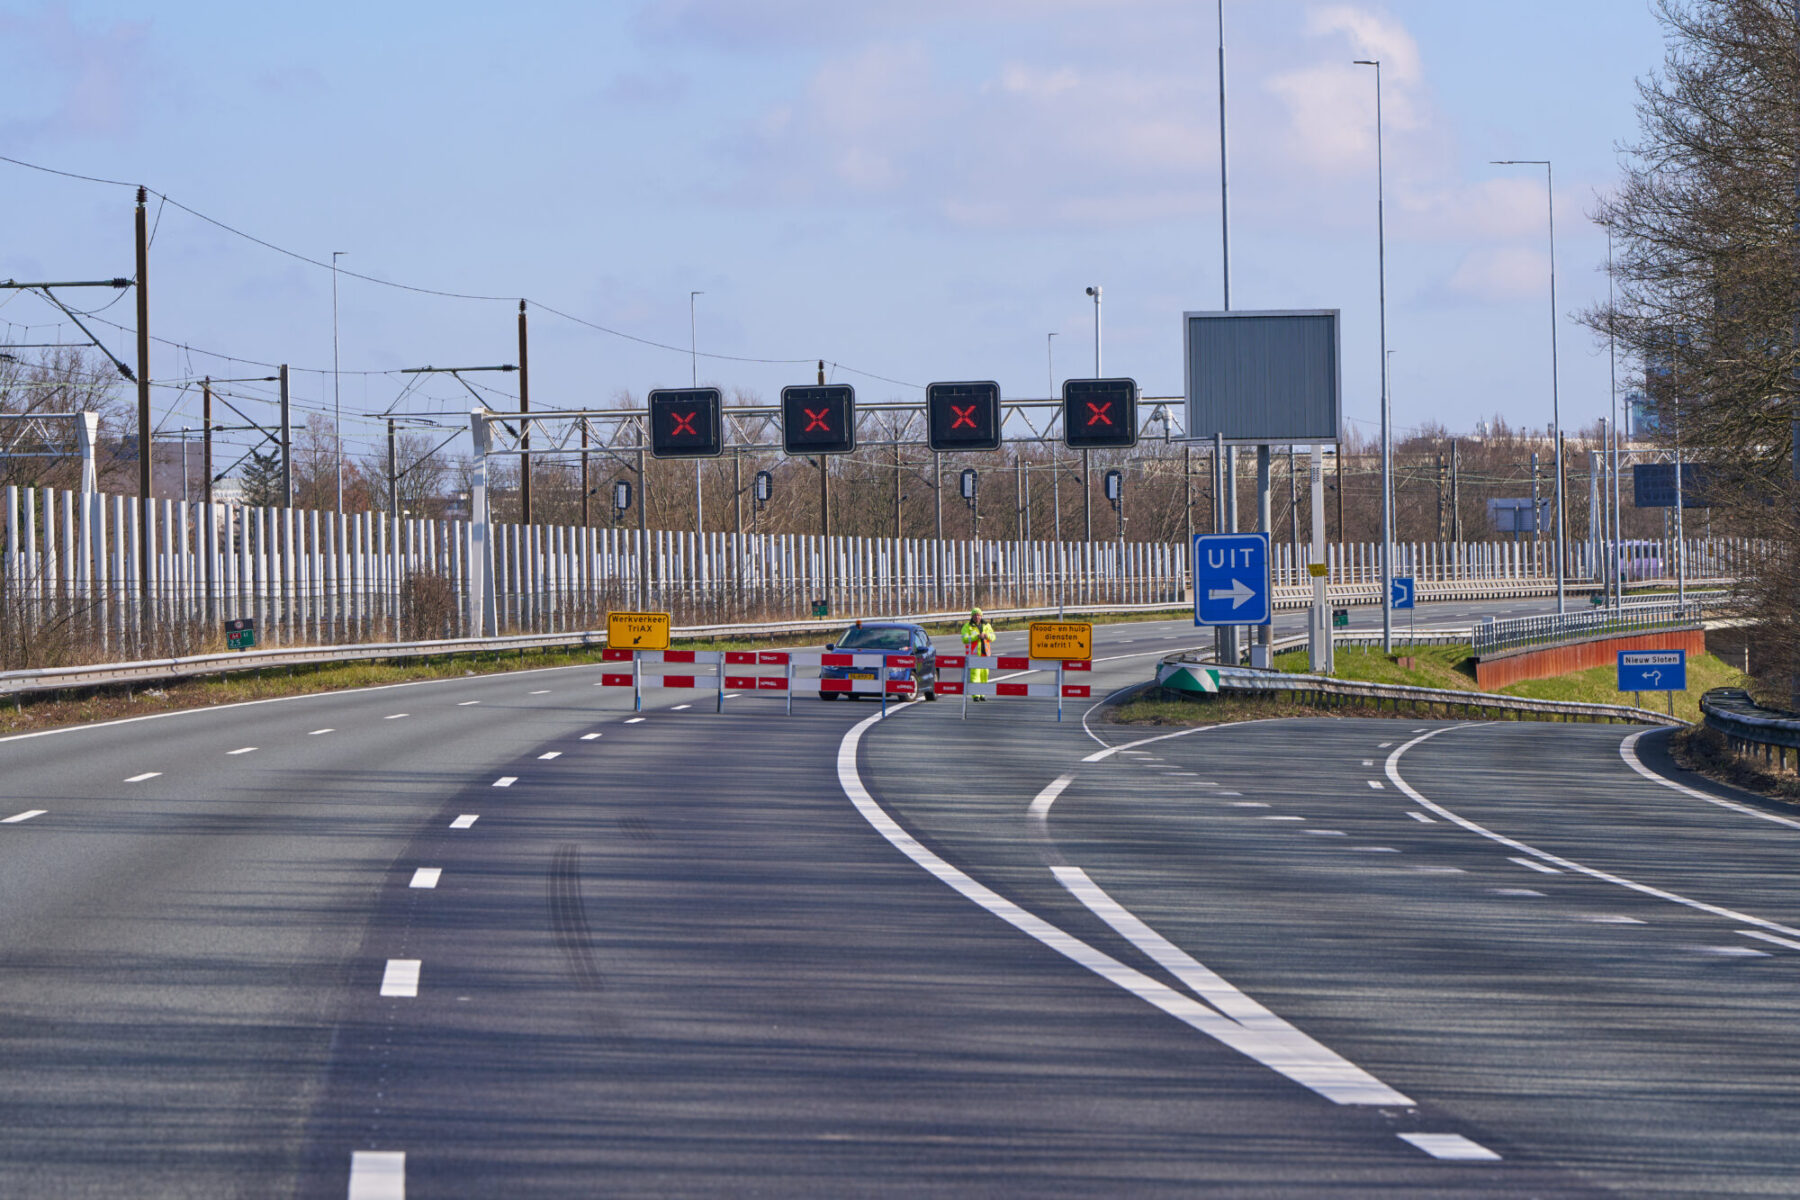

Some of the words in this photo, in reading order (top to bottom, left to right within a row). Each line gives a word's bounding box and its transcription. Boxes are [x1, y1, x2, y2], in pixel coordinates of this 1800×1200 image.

[1208, 548, 1254, 569] UIT
[612, 615, 667, 623] Werkverkeer
[1068, 625, 1089, 633] hulp-
[1625, 656, 1650, 664] Nieuw
[1652, 655, 1677, 663] Sloten
